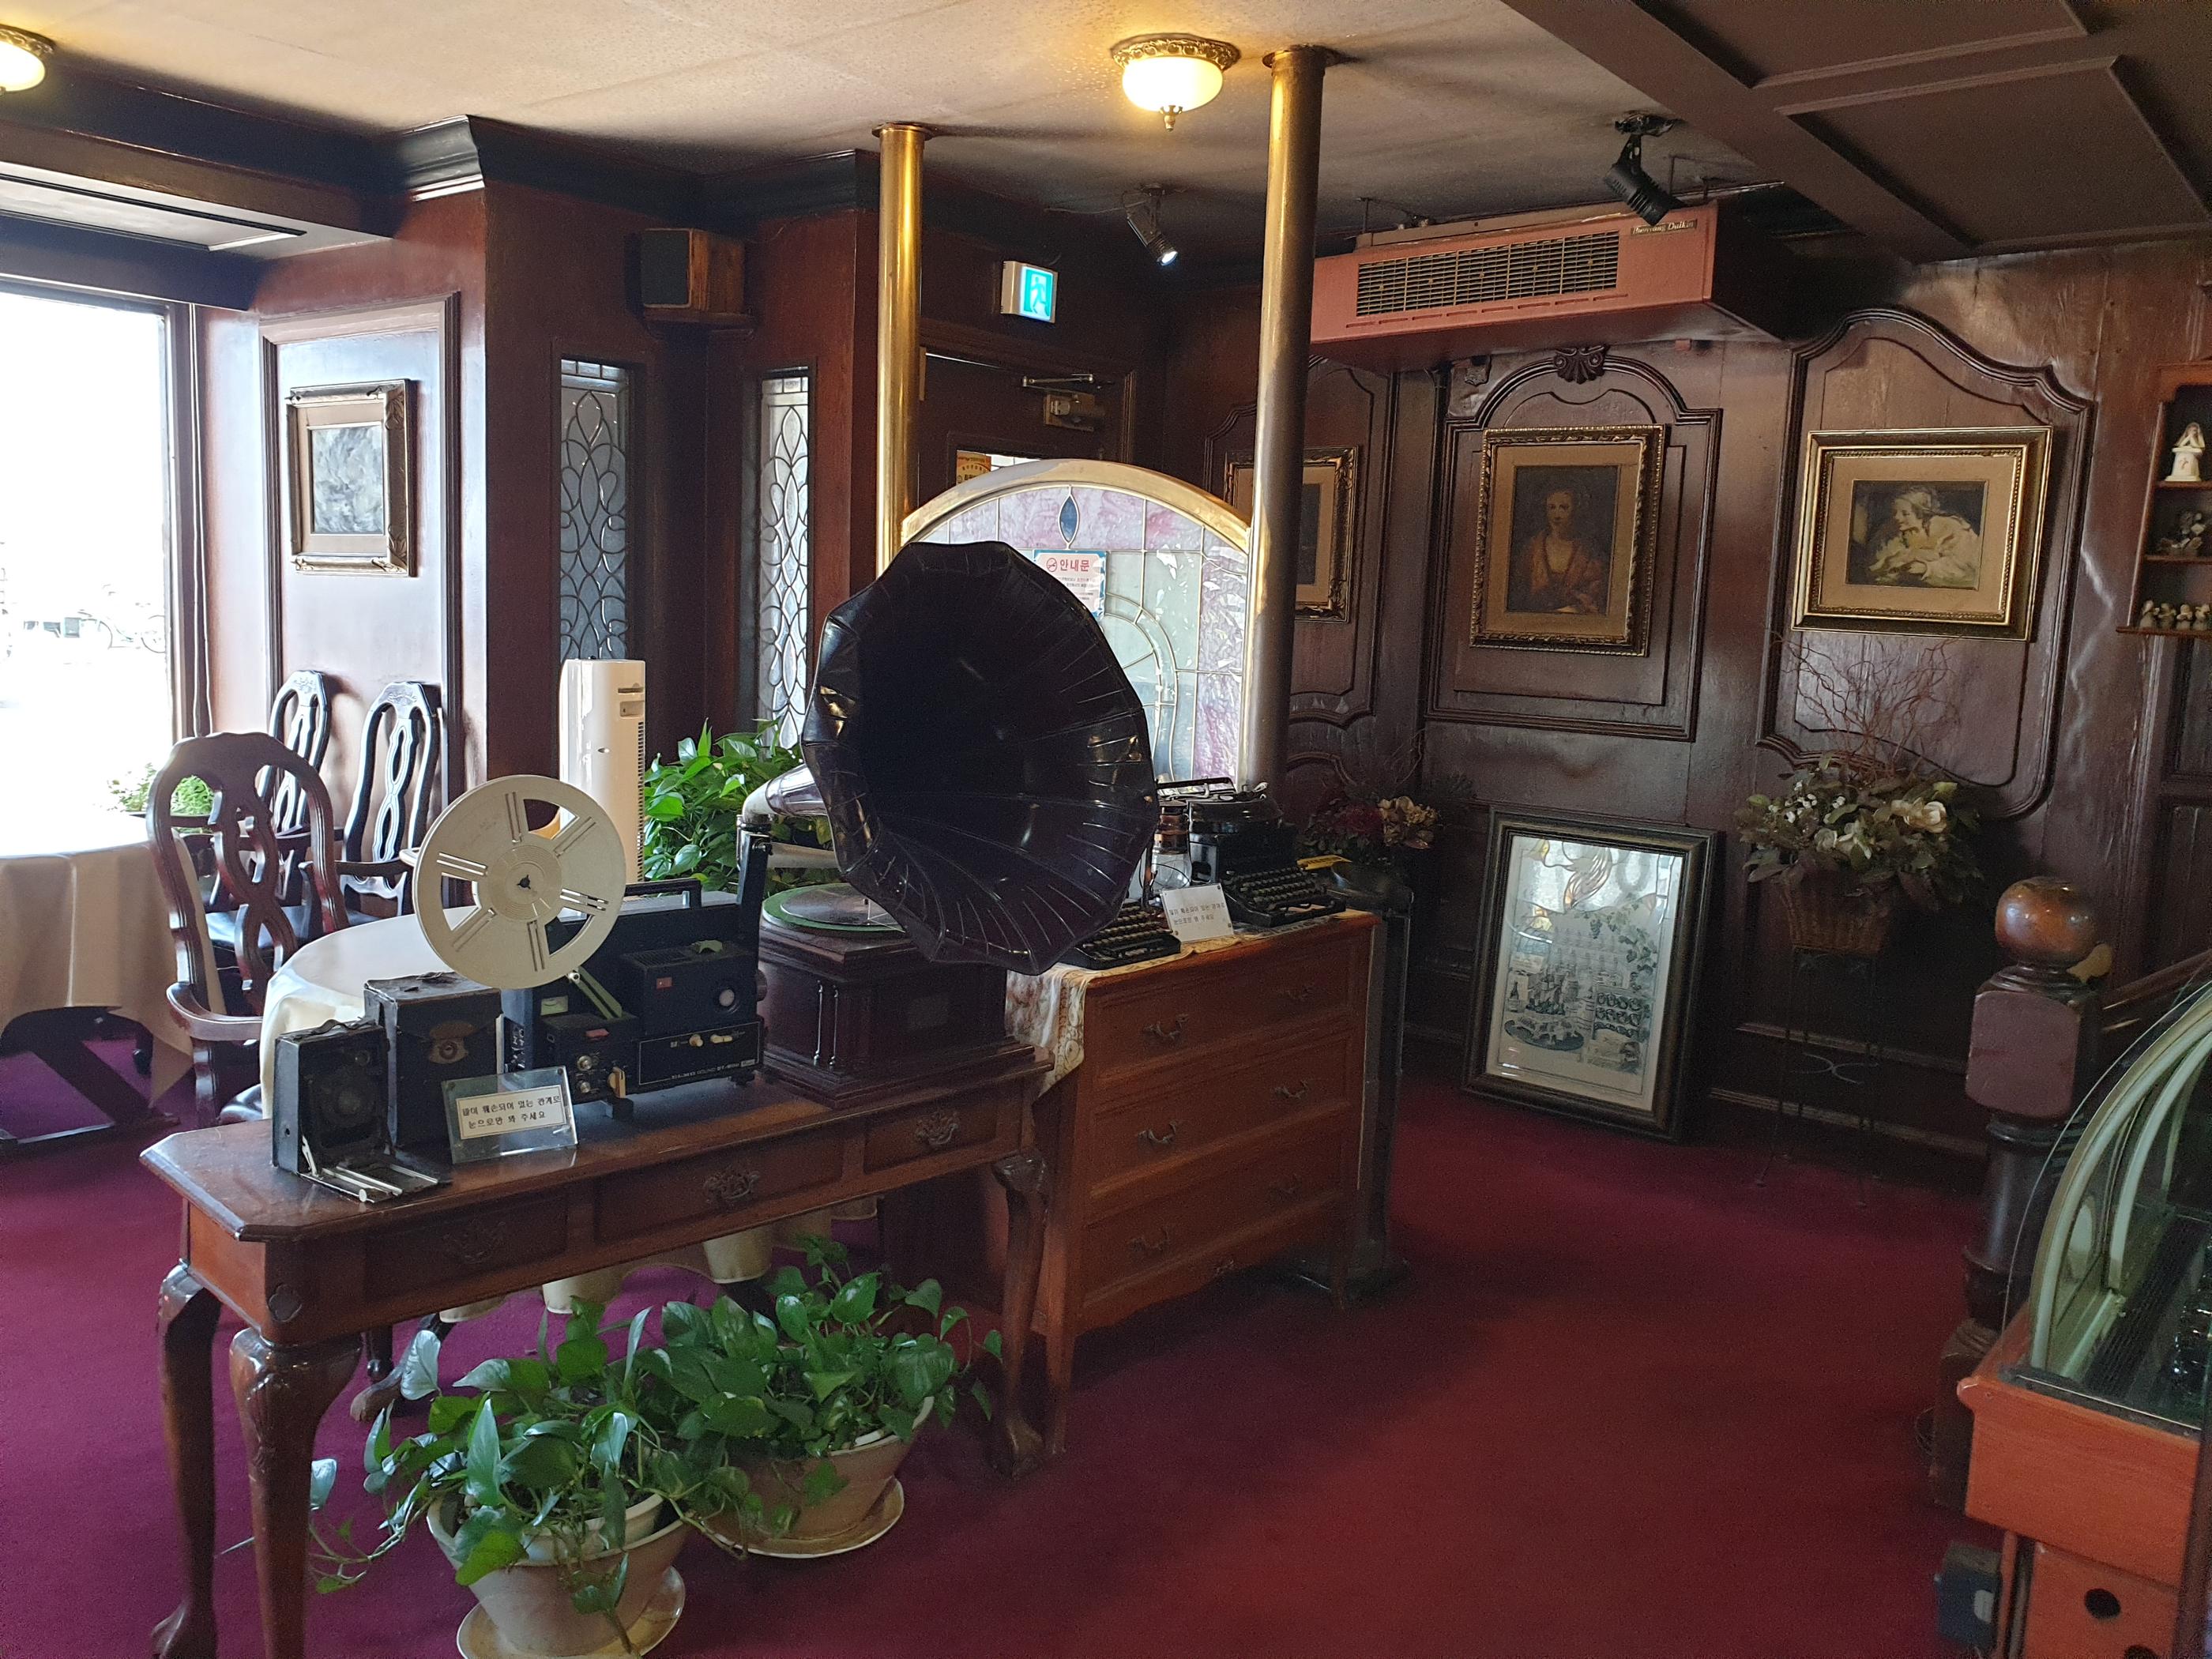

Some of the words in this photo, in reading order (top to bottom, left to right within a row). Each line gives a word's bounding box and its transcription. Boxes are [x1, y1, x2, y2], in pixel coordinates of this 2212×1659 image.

[1059, 559, 1089, 572] 안내문
[468, 1116, 503, 1130] 눈으로만
[521, 1111, 545, 1122] 주세요
